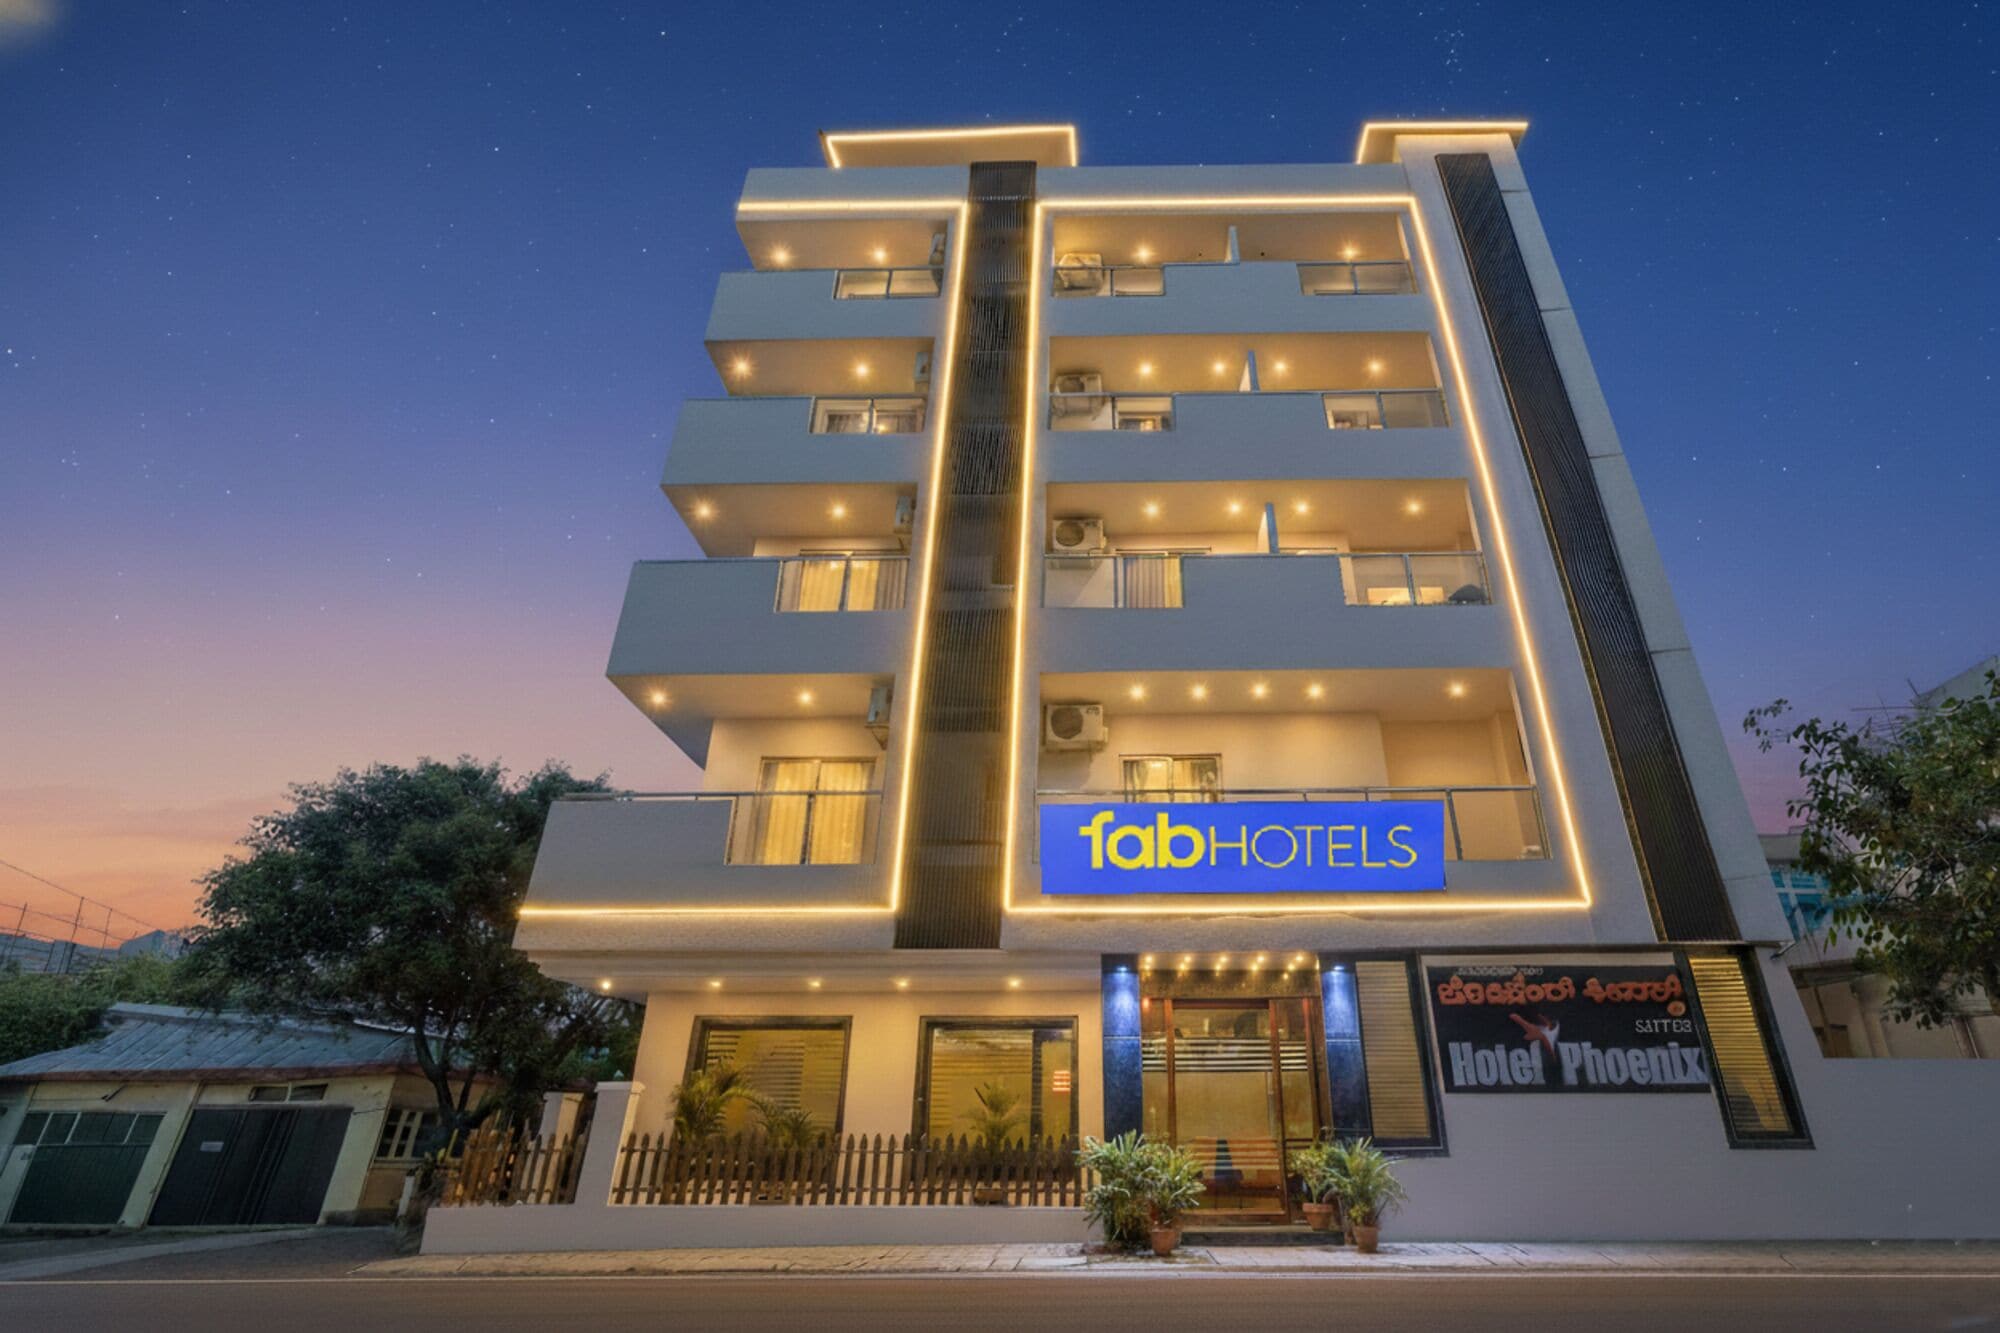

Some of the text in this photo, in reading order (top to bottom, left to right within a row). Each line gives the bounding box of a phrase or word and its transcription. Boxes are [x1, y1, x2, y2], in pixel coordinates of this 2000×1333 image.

[1078, 810, 1417, 870] fabHOTELS
[1449, 1040, 1709, 1086] Hotel Phoenix
